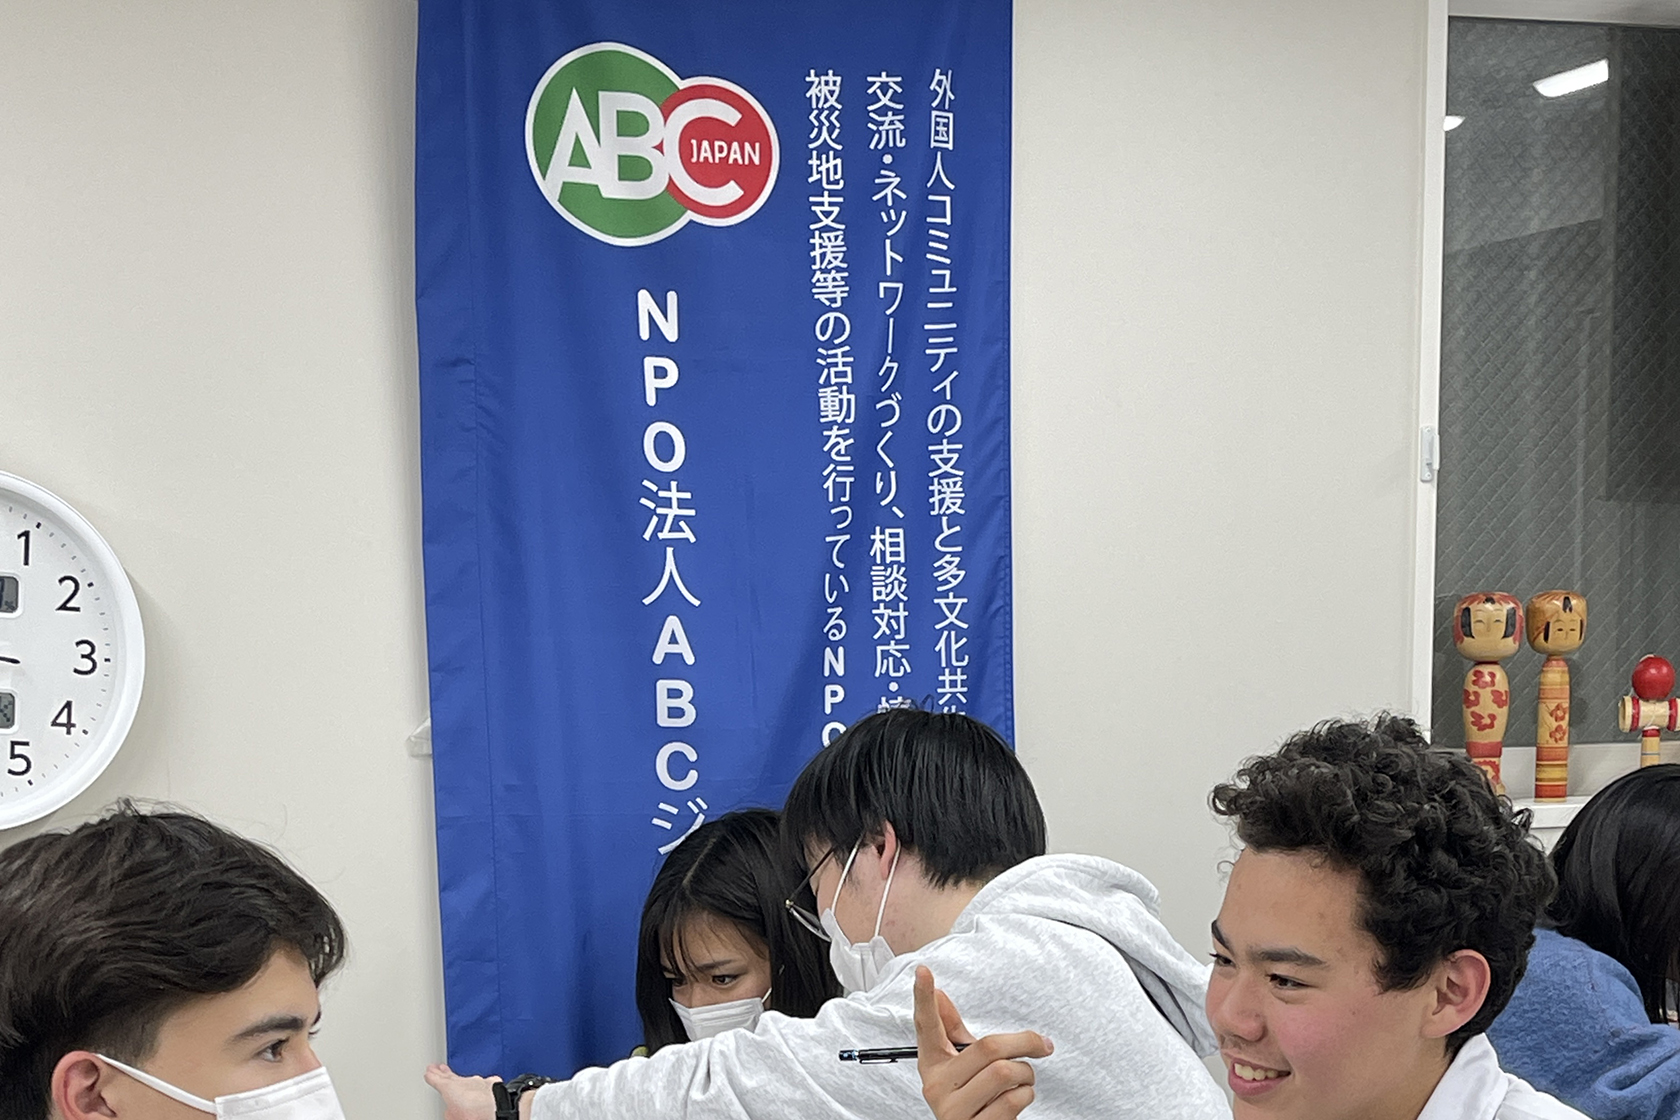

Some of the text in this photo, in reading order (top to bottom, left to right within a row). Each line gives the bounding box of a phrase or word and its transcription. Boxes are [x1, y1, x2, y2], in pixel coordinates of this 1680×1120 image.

[544, 86, 745, 206] ABC
[690, 139, 760, 166] JAPAN
[923, 68, 969, 715] 外国人コミュニティの支援と多文化共
[17, 530, 31, 566] 1
[55, 575, 82, 612] 2
[73, 639, 98, 676] 3
[50, 700, 77, 735] 4
[7, 741, 32, 776] 5
